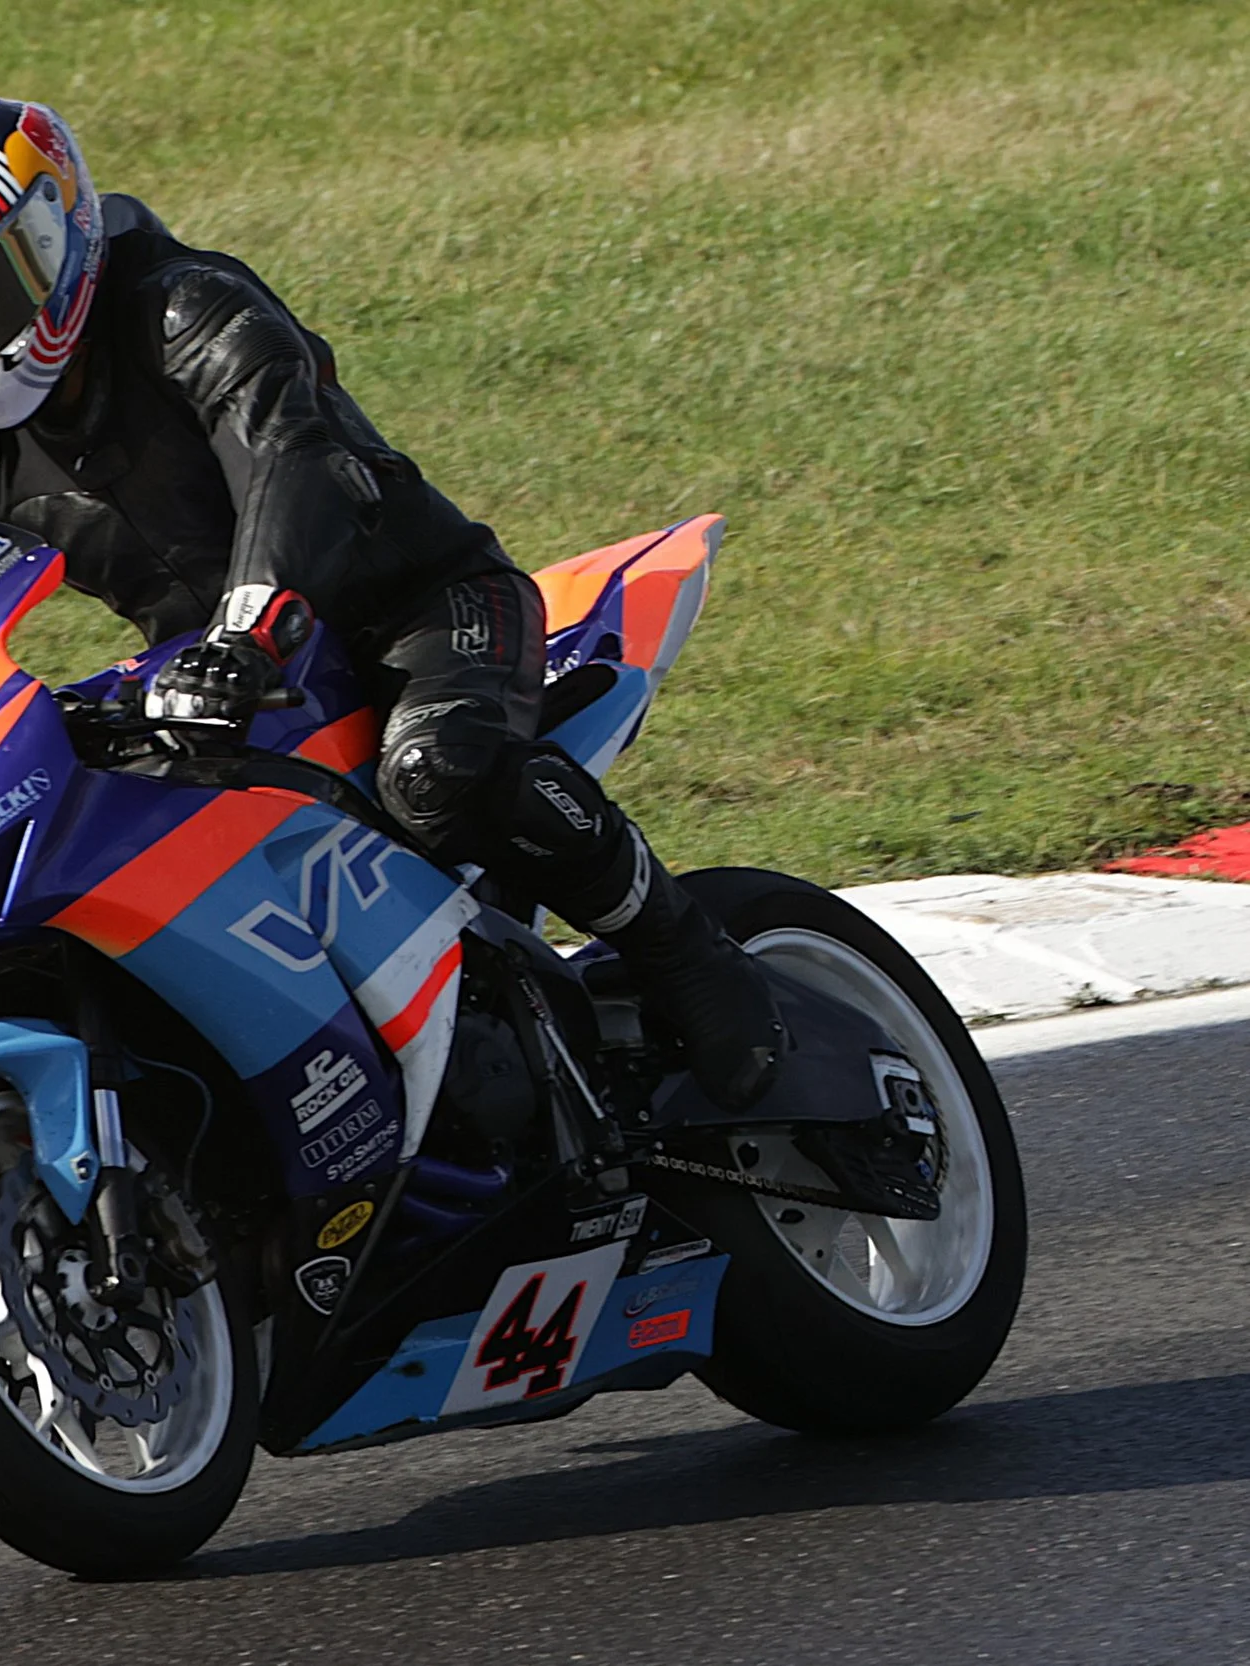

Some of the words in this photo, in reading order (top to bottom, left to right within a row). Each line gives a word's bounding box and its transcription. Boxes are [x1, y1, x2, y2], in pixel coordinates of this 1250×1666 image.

[295, 1081, 339, 1123] ROCK
[338, 1063, 365, 1089] OIL
[474, 1271, 588, 1399] 44
